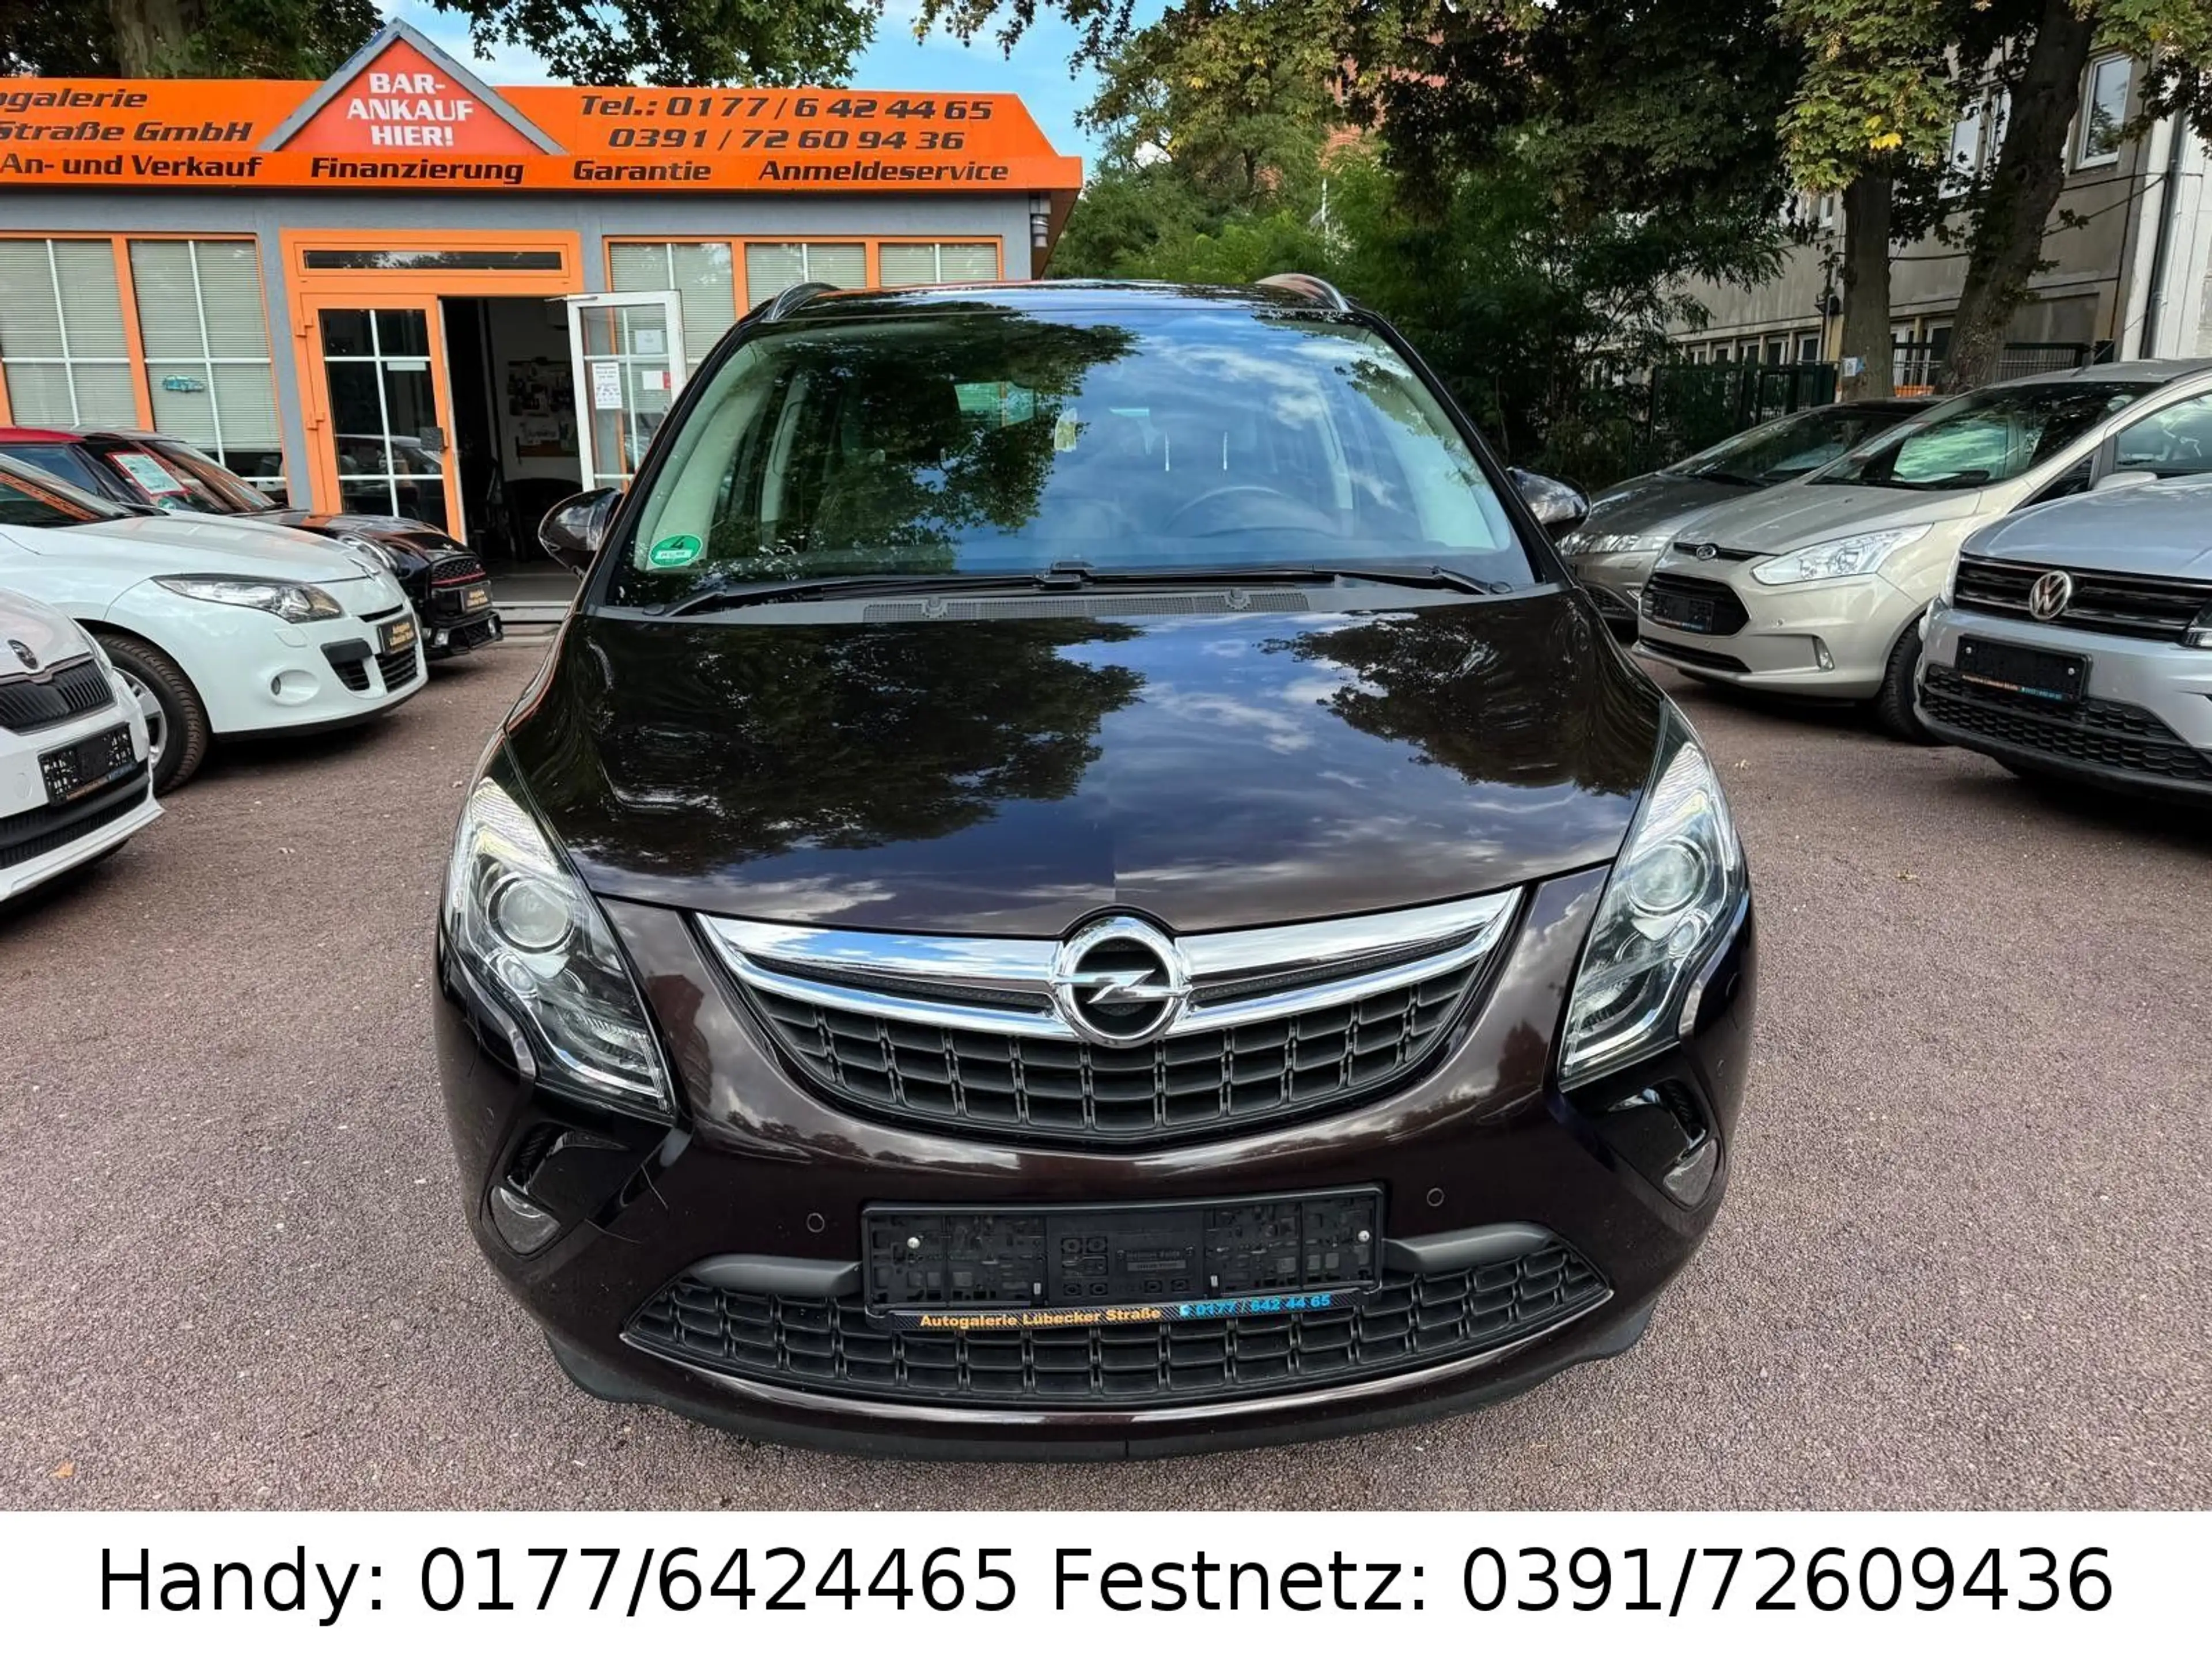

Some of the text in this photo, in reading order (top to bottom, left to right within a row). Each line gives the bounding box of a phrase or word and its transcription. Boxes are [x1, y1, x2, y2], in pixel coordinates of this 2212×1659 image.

[369, 73, 446, 94] BAR-
[347, 98, 474, 121] ANKAUF
[581, 95, 658, 116] Tel.:
[826, 99, 878, 118] 42
[884, 100, 936, 119] 44
[944, 101, 994, 120] 65
[133, 121, 253, 141] GmbH
[371, 125, 454, 146] HIER!
[608, 128, 707, 148] 0391
[741, 129, 790, 149] 72
[797, 130, 849, 149] 60
[856, 131, 907, 150] 94
[915, 131, 965, 150] 36
[0, 153, 263, 177] An- und Verkauf
[310, 157, 525, 184] Finanzierung
[573, 160, 711, 181] Garantie
[757, 160, 1009, 181] Anmeldeservice
[1285, 1296, 1306, 1309] 44
[1310, 1293, 1331, 1307] 65
[920, 1307, 1161, 1328] Autogalerie Lübecker Straße
